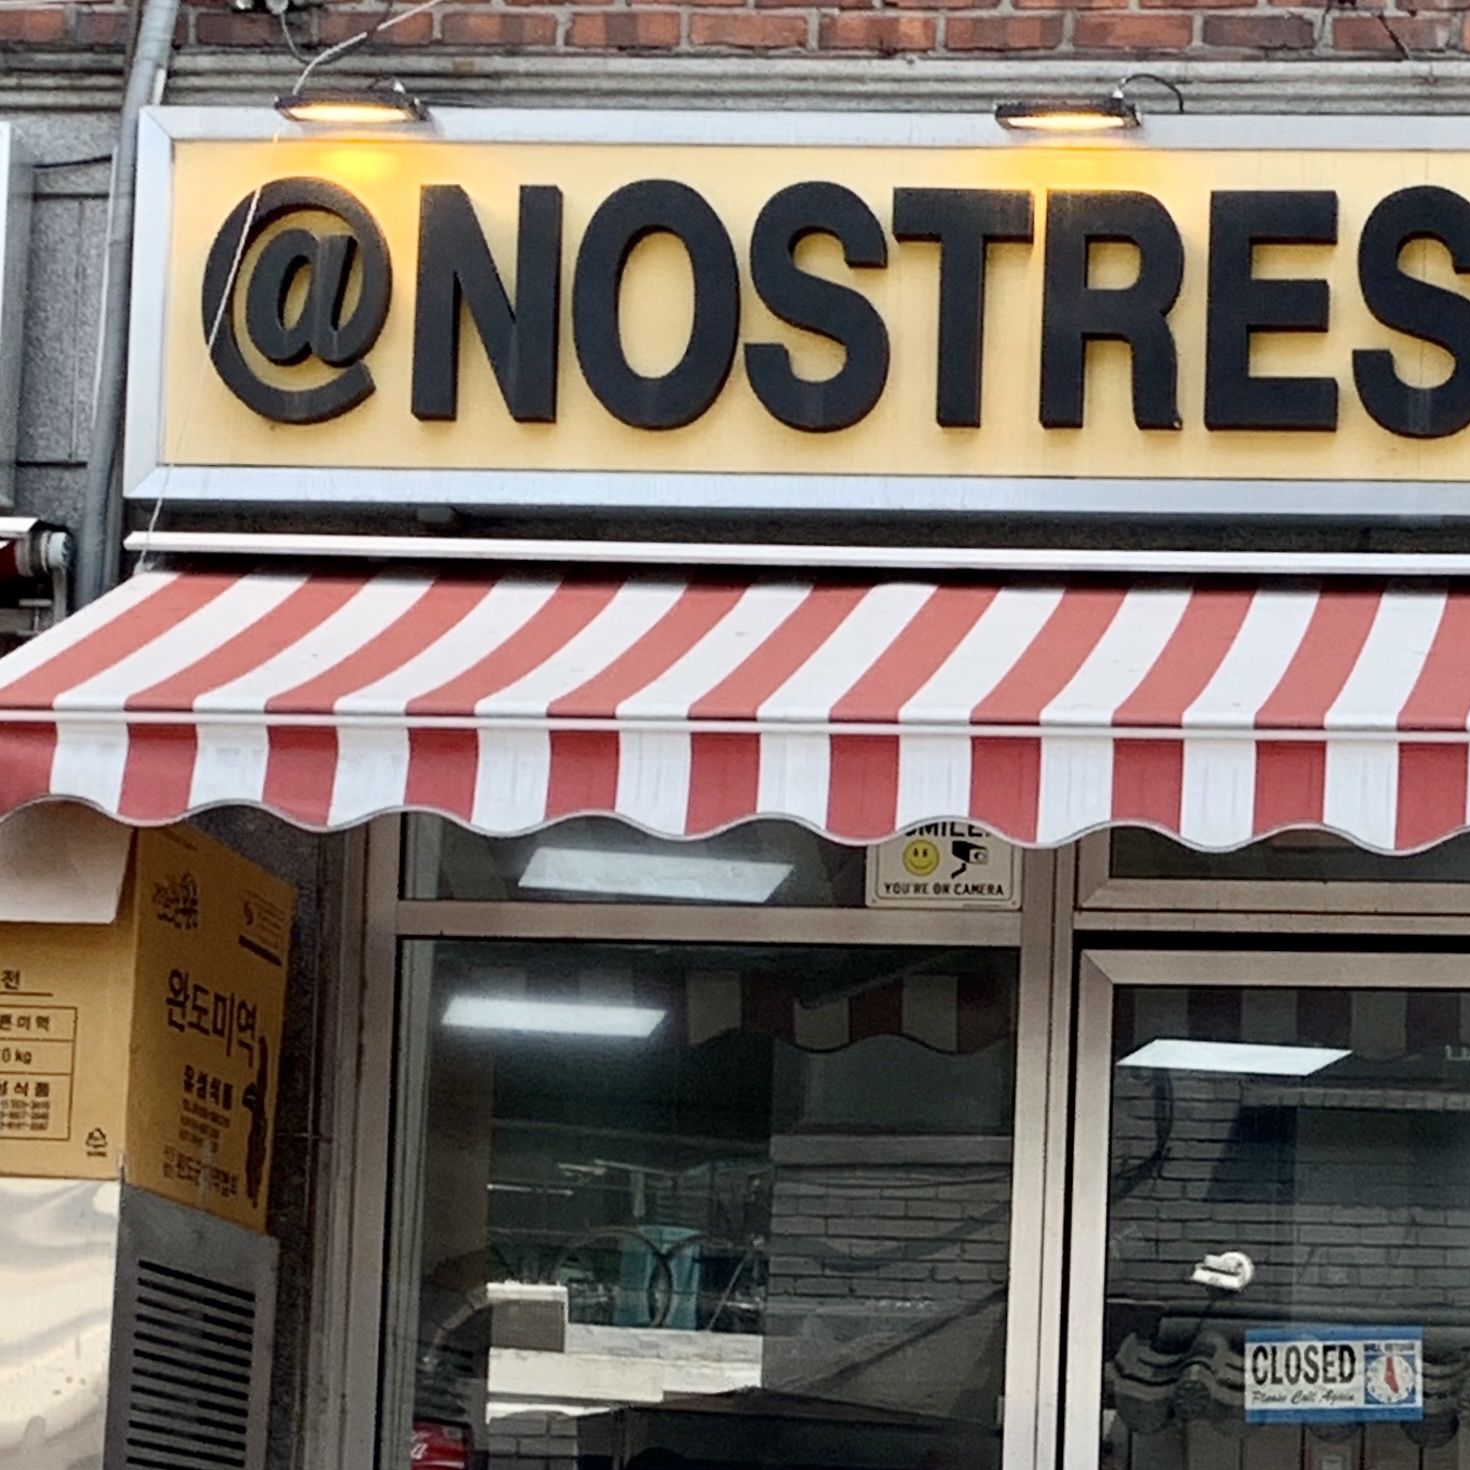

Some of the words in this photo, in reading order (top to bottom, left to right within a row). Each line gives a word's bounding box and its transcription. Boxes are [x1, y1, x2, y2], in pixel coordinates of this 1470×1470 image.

[933, 883, 949, 895] ON
[954, 883, 1004, 896] CAMERA
[166, 968, 259, 1068] 완도미역
[1252, 1344, 1356, 1385] CLOSED
